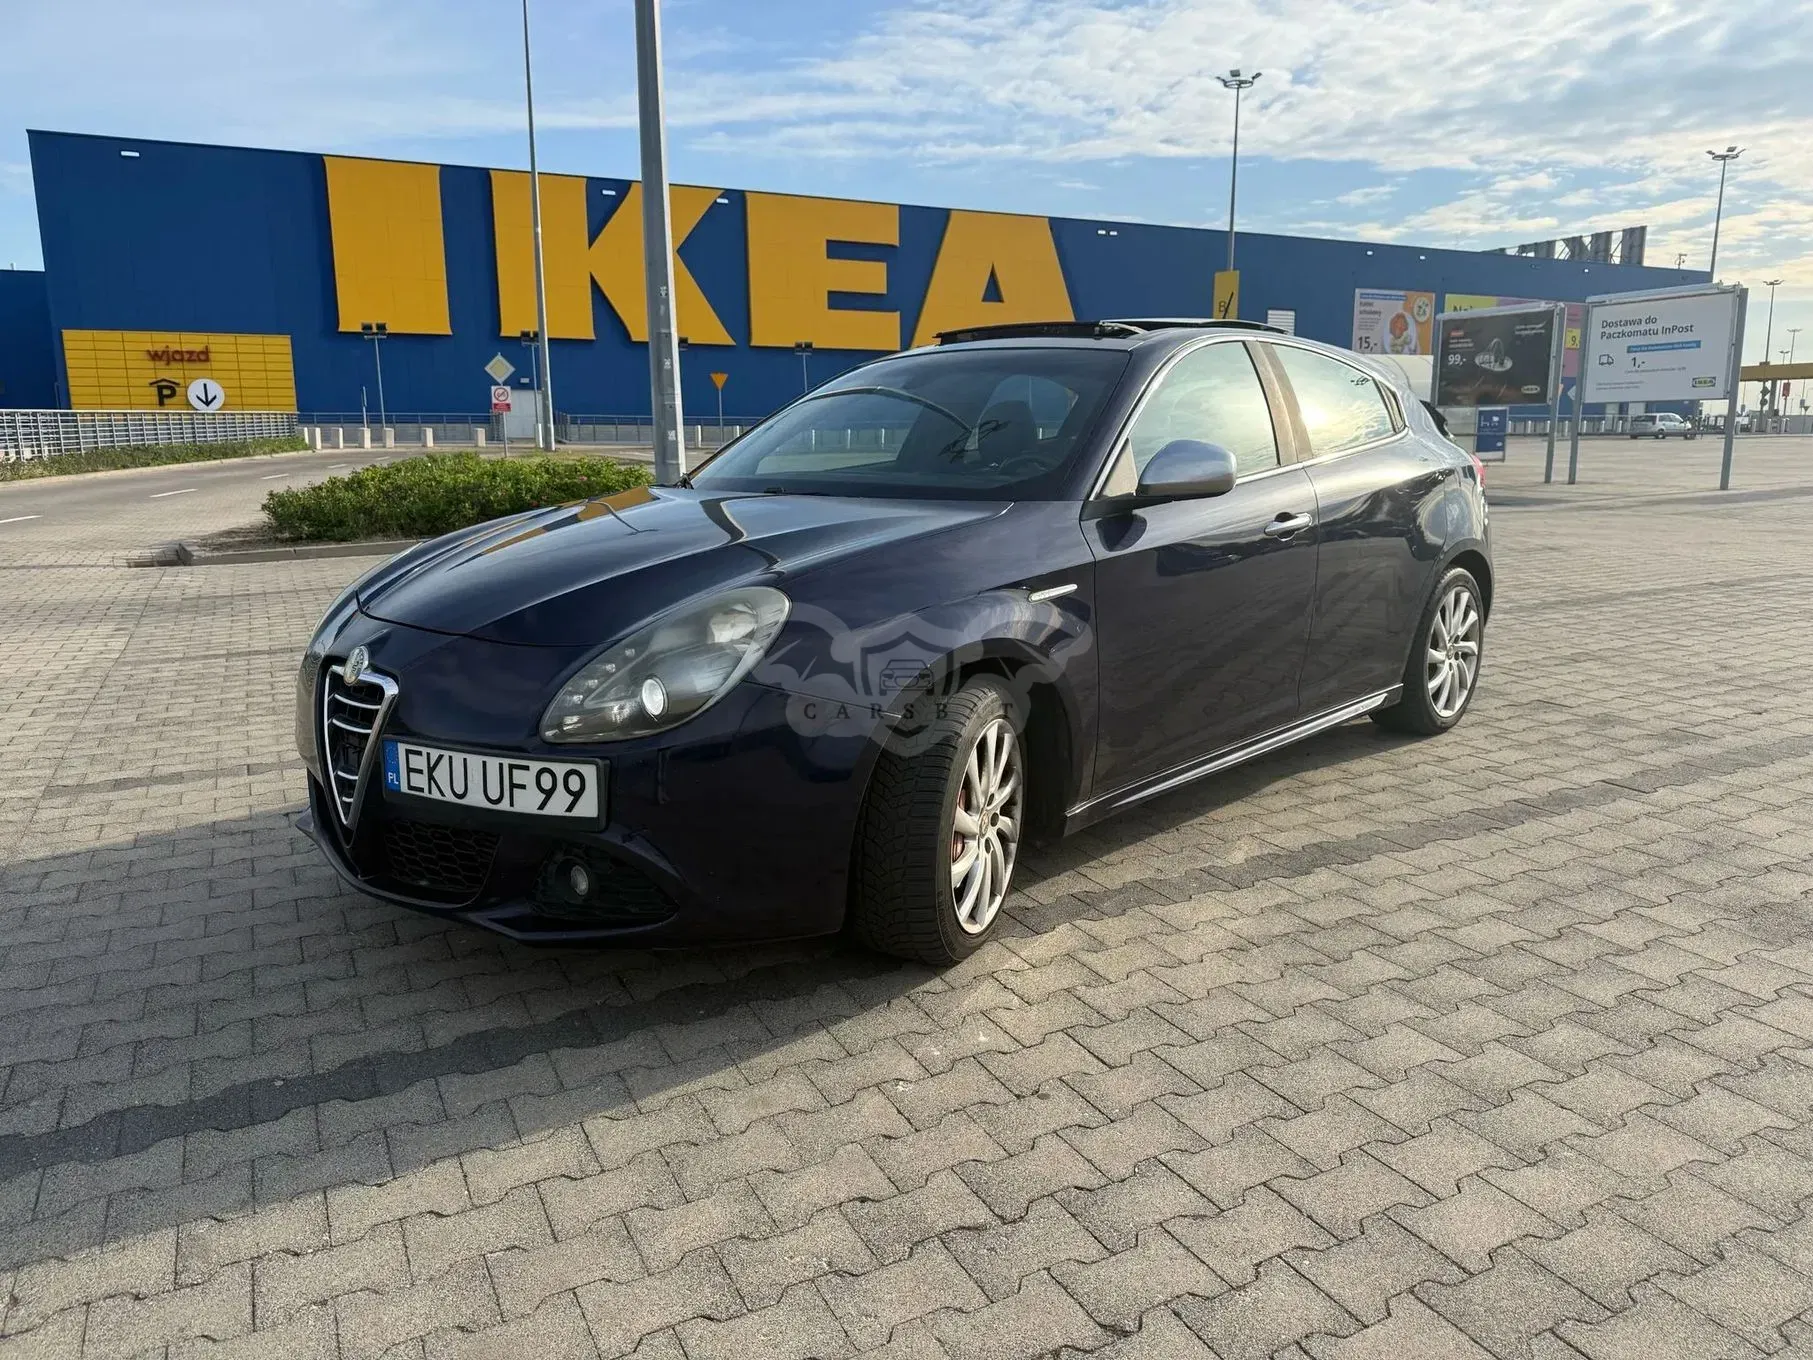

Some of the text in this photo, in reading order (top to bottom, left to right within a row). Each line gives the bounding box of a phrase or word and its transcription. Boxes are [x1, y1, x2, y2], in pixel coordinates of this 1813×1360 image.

[324, 155, 1076, 350] IKEA
[1601, 315, 1657, 329] Dostawa do
[1600, 324, 1694, 340] Paczkomatu InPost
[1358, 336, 1378, 351] 15,-
[146, 344, 210, 366] wjazd
[1448, 354, 1467, 366] 99,-
[1631, 356, 1646, 369] 1,-
[156, 384, 177, 407] P
[387, 773, 399, 785] PL
[405, 749, 586, 813] EKU UF99
